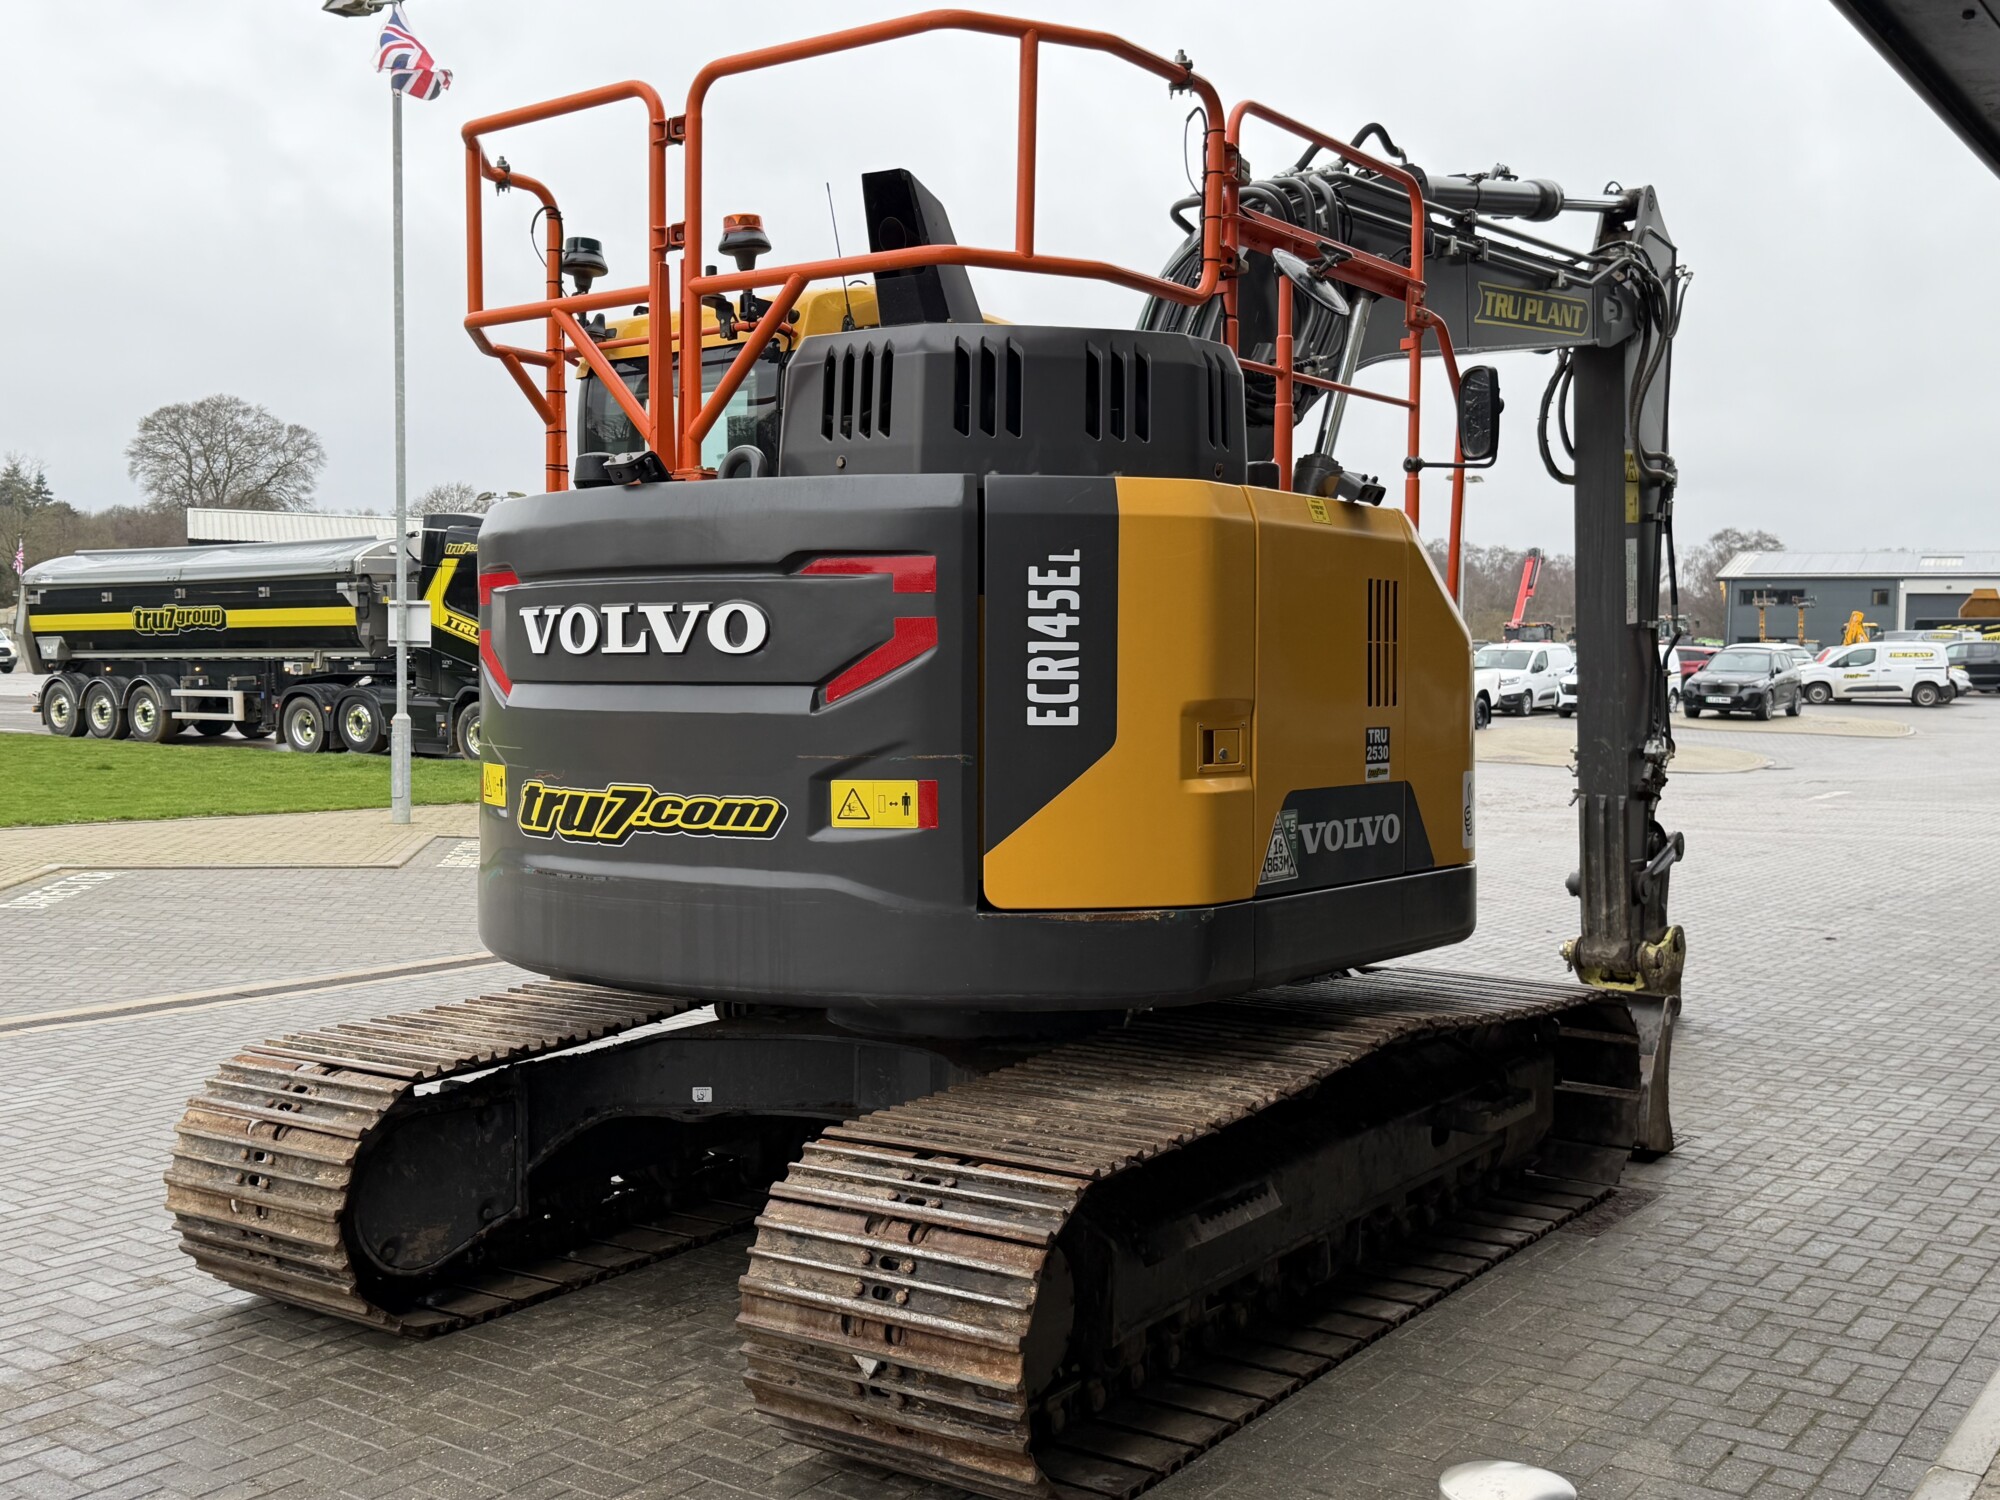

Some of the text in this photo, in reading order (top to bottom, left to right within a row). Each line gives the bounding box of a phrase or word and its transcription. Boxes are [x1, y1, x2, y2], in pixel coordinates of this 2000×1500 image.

[1485, 291, 1583, 329] TRU PLANT
[519, 602, 769, 655] VOLVO
[1027, 549, 1080, 726] ECR145EL
[1366, 745, 1389, 761] 2530
[1367, 728, 1388, 744] TRU
[519, 781, 785, 845] tru7.com
[1298, 813, 1401, 855] VOLVO
